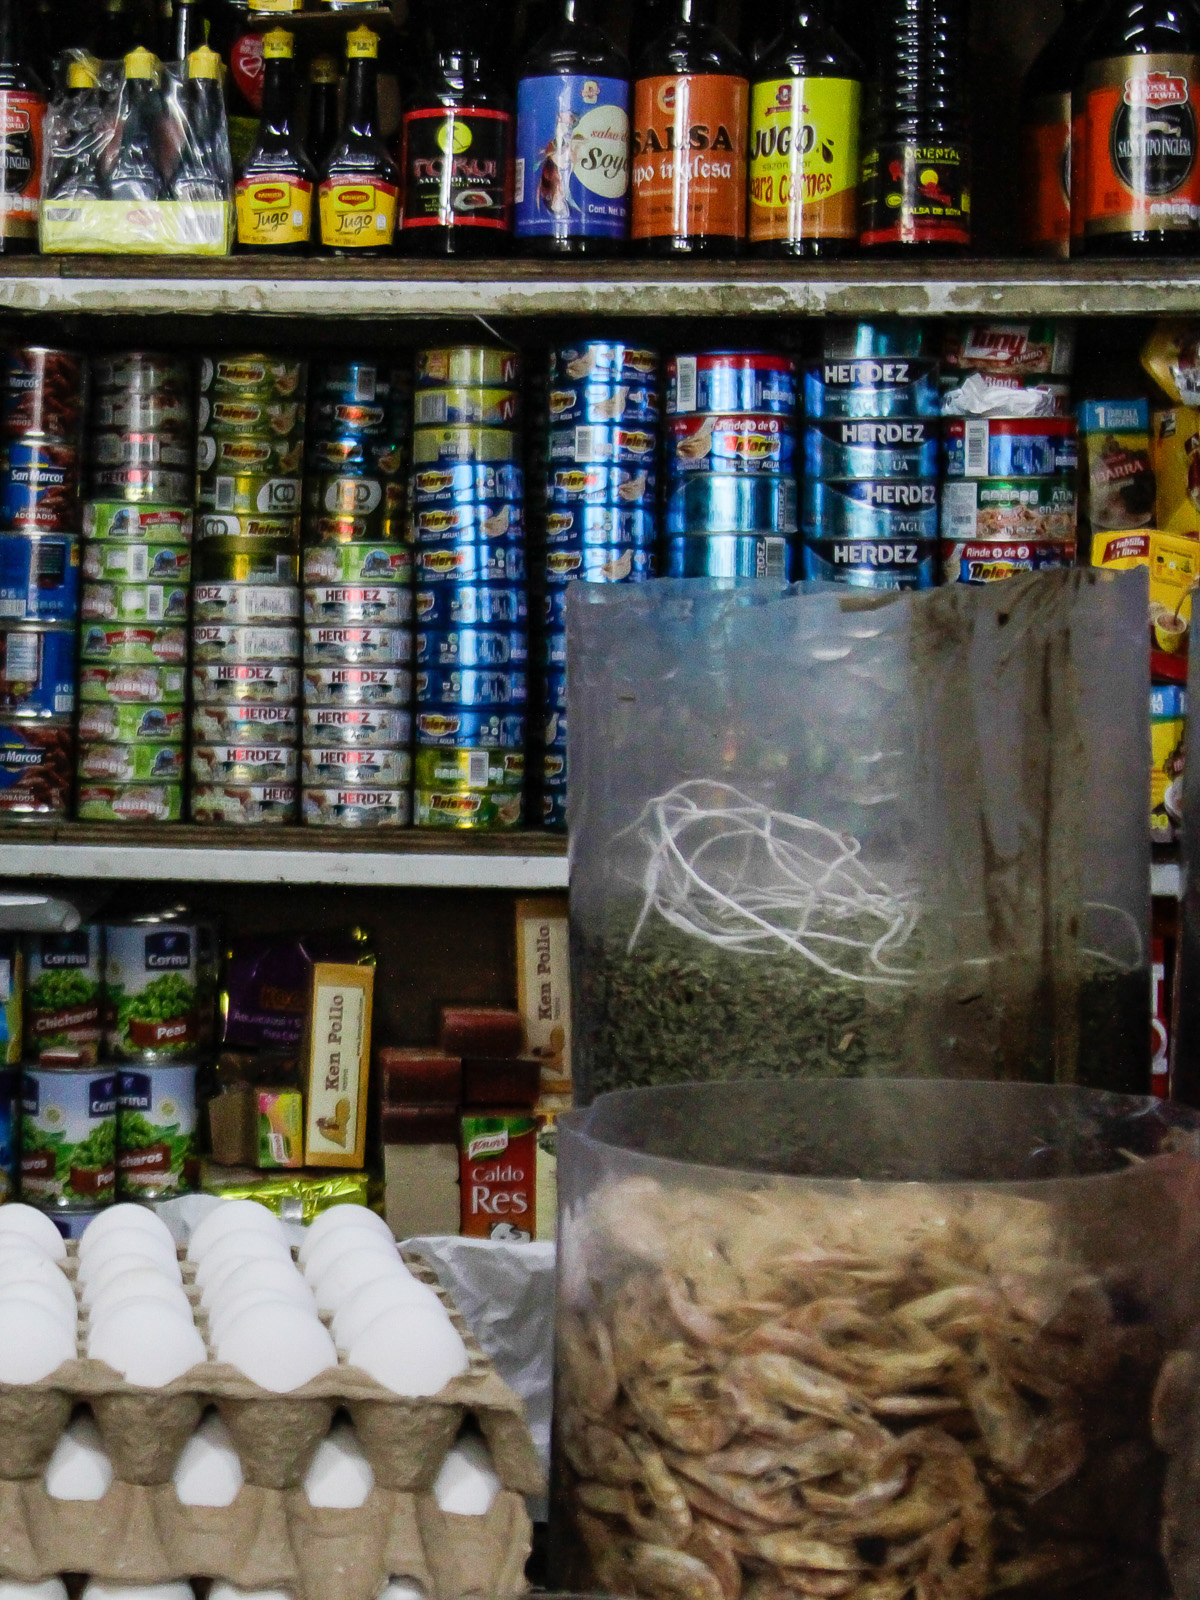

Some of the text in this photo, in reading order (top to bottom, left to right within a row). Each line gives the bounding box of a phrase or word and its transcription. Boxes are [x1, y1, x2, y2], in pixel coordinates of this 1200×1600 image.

[751, 124, 816, 162] JUGO
[762, 159, 812, 173] sazonor
[252, 211, 289, 231] Jugo
[335, 214, 373, 235] Jugo
[824, 364, 909, 384] HERDEZ
[842, 423, 924, 444] HERDEZ
[11, 469, 29, 481] San
[866, 485, 936, 506] HERDEZ
[834, 544, 918, 566] HERDEZ
[966, 548, 991, 558] Rinde
[1004, 547, 1017, 558] de
[195, 587, 222, 600] RDEZ
[325, 589, 382, 602] HERDEZ
[318, 629, 373, 643] HERDEZ
[217, 665, 274, 680] HERDEZ
[331, 670, 388, 684] HERDEZ
[239, 707, 292, 722] HERDEZ
[317, 711, 372, 725] HERDEZ
[6, 750, 42, 764] Marcos
[226, 748, 282, 762] HERDEZ
[320, 751, 376, 765] HERDEZ
[337, 791, 393, 806] HERDEZ
[536, 924, 553, 1022] Ken Pollo
[156, 1023, 187, 1041] Peas
[324, 993, 345, 1093] Ken Pollo
[471, 1164, 525, 1184] Caldo
[471, 1186, 528, 1215] Res
